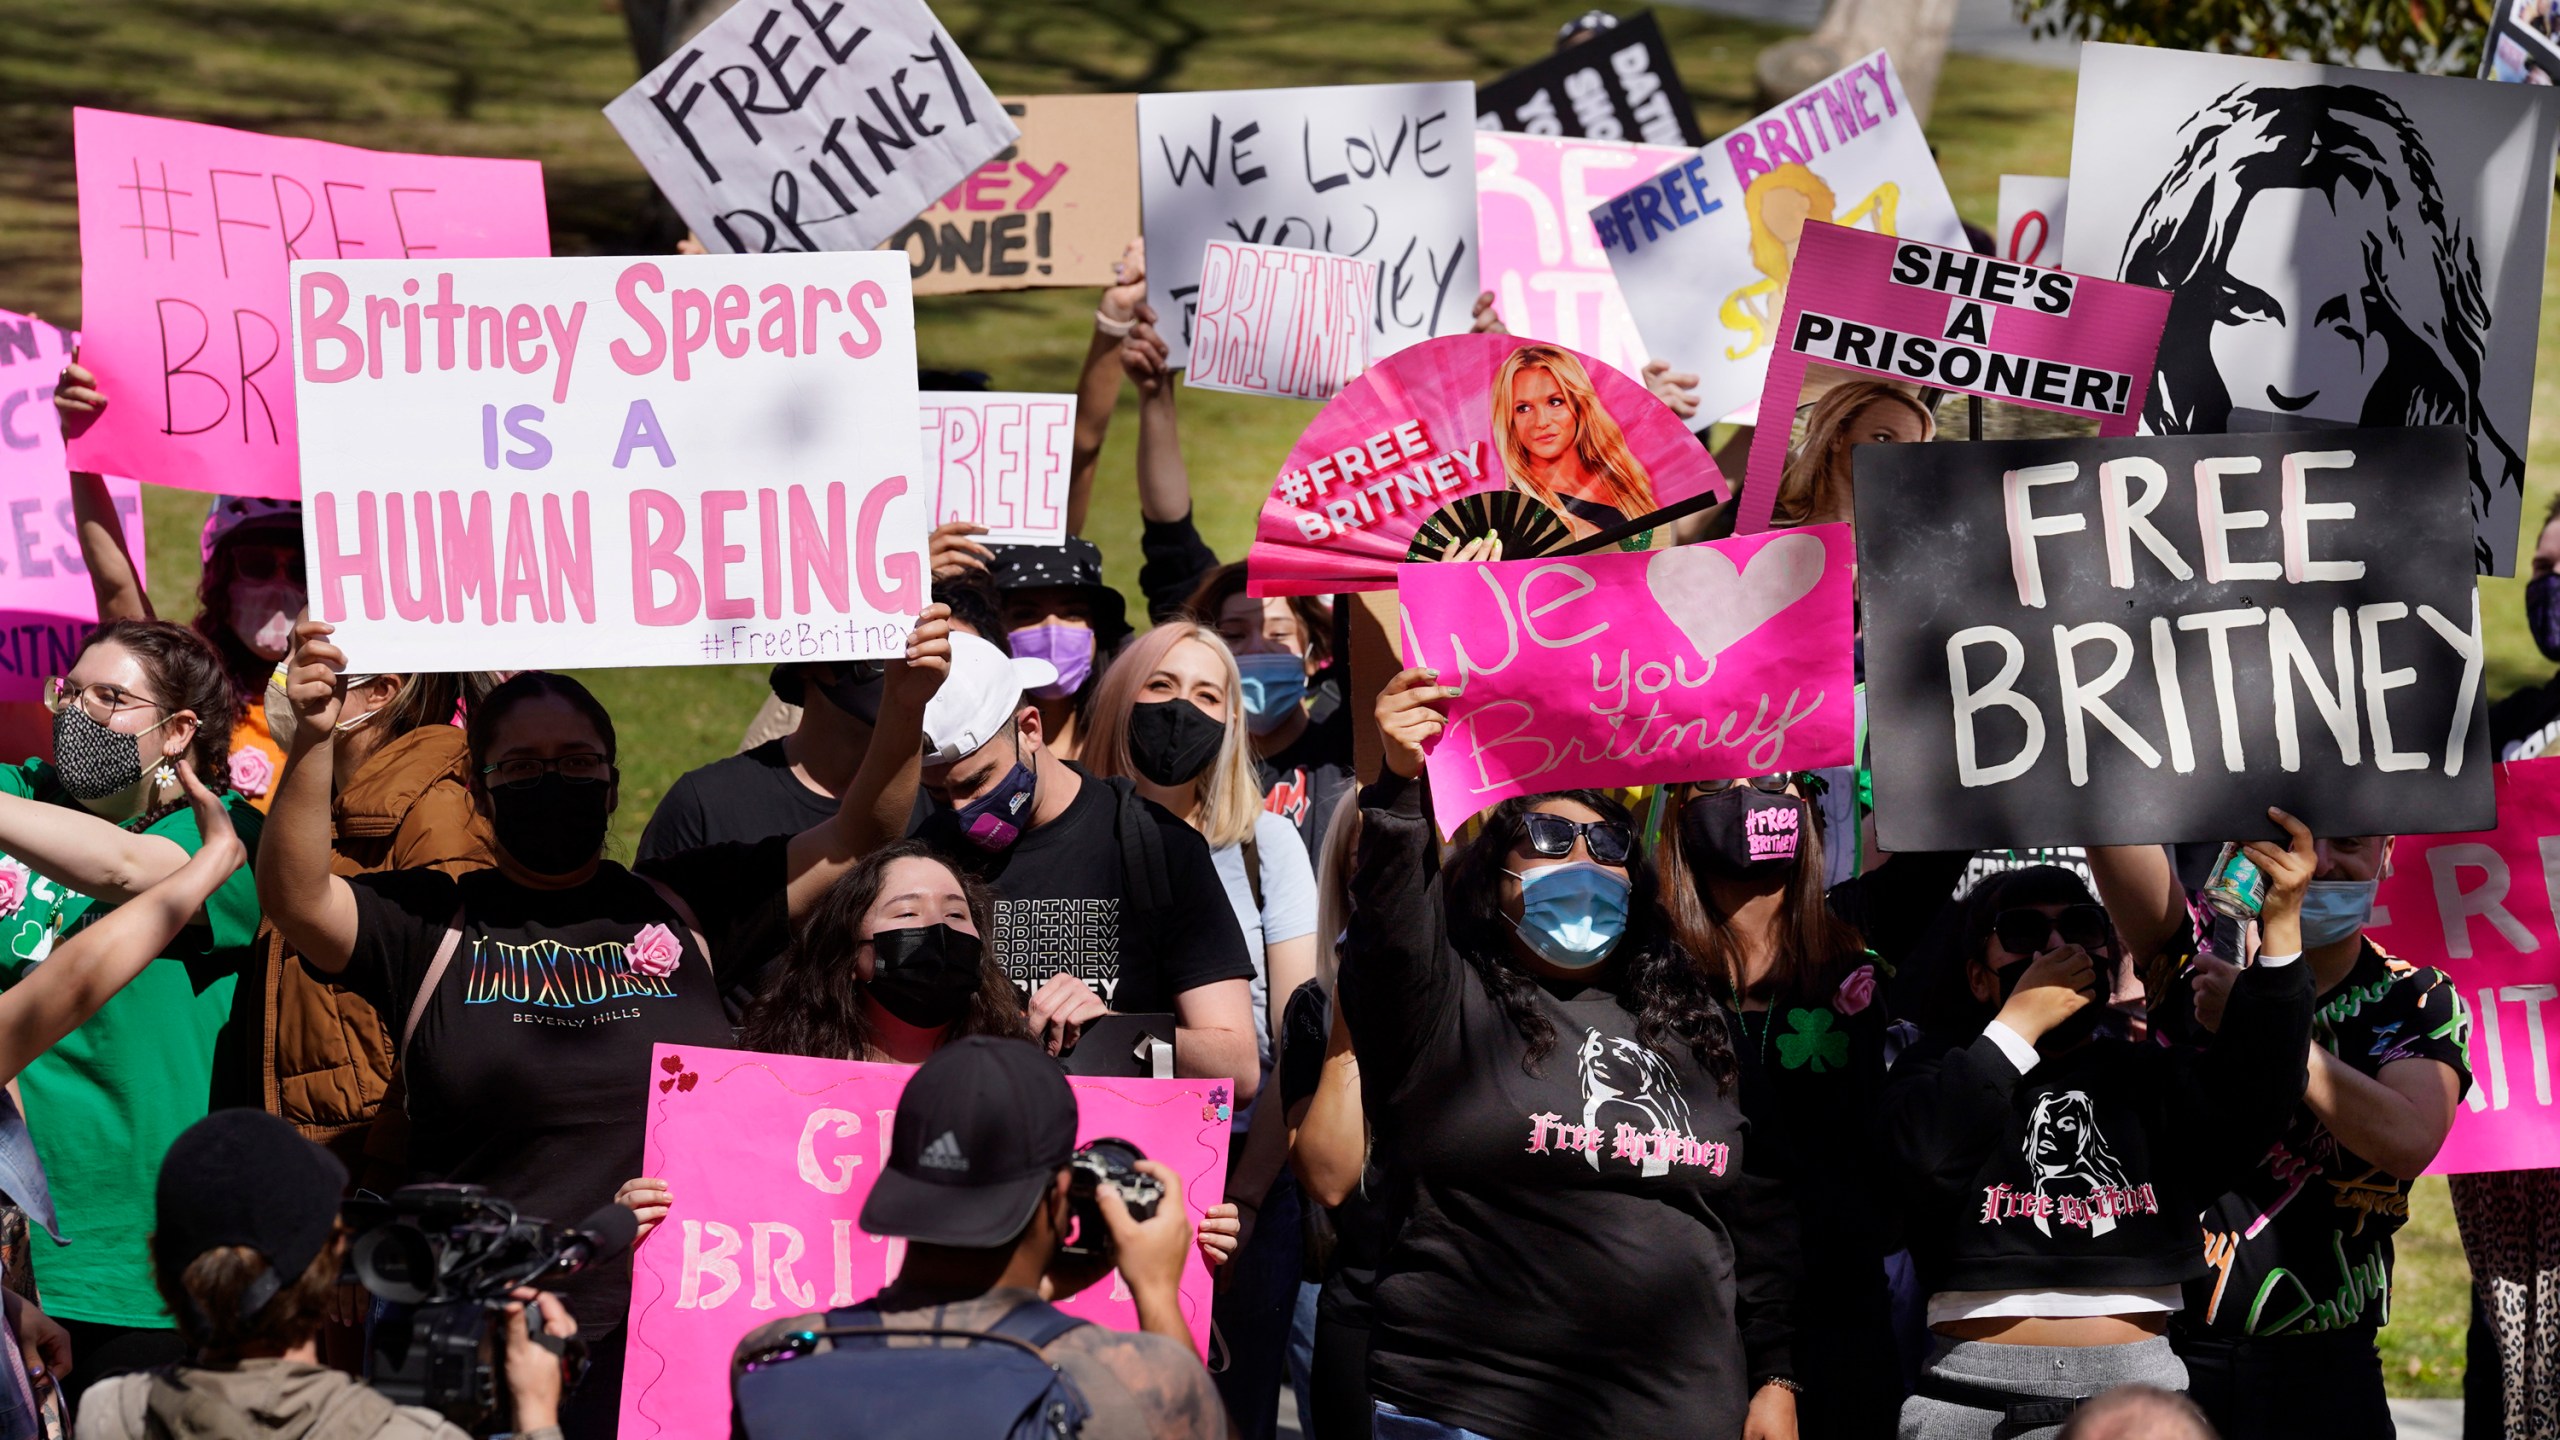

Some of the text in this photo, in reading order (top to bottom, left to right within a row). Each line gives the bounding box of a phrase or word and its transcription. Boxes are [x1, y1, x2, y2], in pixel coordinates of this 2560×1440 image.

[650, 0, 871, 184] FREE
[713, 31, 977, 254] BRITNEY
[1159, 111, 1451, 193] WE LOVE
[1595, 52, 1898, 254] #FREE BRITNEY
[118, 157, 437, 279] #FREE
[1190, 244, 1377, 399] BRITNEY
[1892, 244, 2074, 315] SHE'S
[1943, 302, 1988, 346] A
[299, 262, 888, 404] Britney Spears
[1792, 312, 2133, 414] PRISONER!
[482, 398, 677, 471] IS A
[1278, 418, 1430, 507] #FREE
[1295, 440, 1482, 541] BRITNEY
[2003, 449, 2366, 609] FREE
[314, 474, 923, 627] HUMAN BEING
[1588, 648, 1718, 715] you
[1946, 586, 2485, 788] BRITNEY
[1449, 688, 1826, 794] Britney
[513, 1007, 641, 1029] BEVERLY HILLS
[1525, 1111, 1730, 1177] Free Britney
[1979, 1183, 2159, 1229] Free Britney
